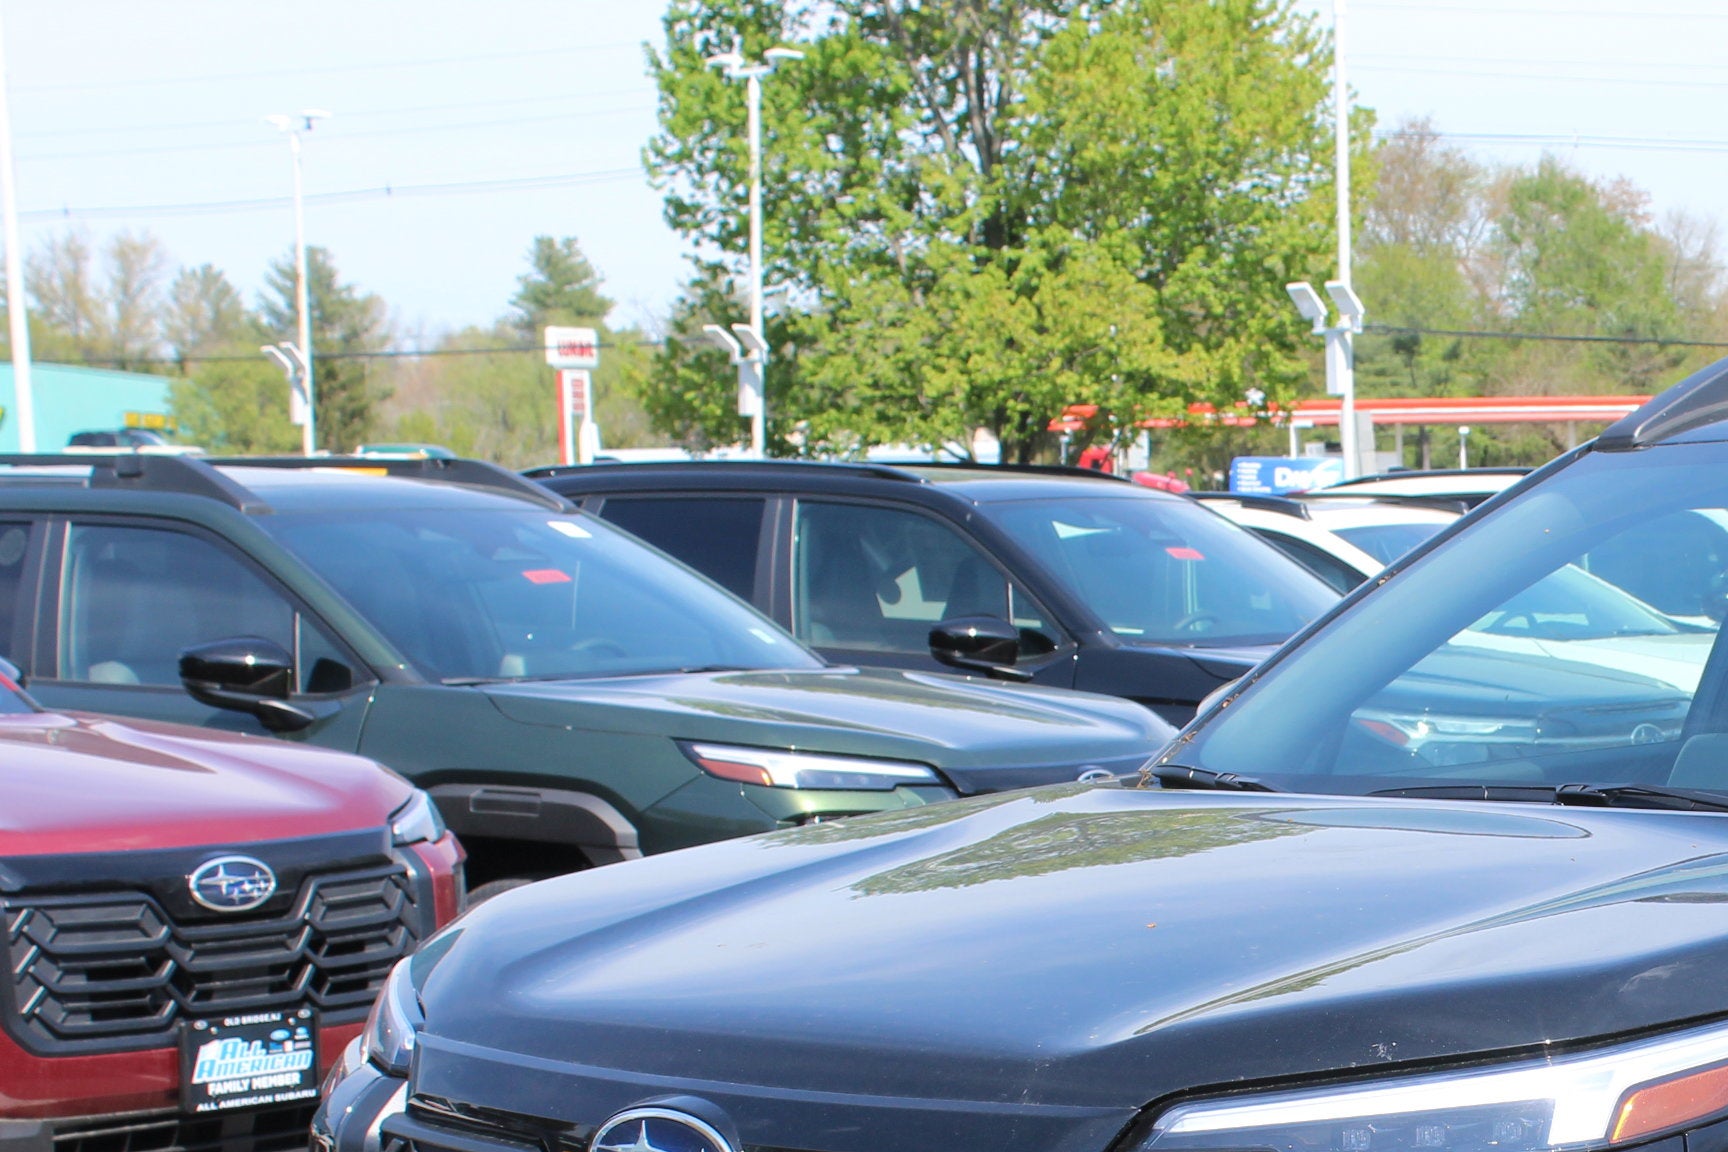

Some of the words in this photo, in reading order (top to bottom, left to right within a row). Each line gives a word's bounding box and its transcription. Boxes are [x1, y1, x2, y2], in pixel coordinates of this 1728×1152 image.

[207, 1079, 250, 1096] FAMILY
[252, 1072, 301, 1090] MEMBER
[196, 1103, 218, 1112] ALL
[219, 1095, 273, 1109] AMERICAN
[274, 1089, 317, 1102] SUBARU
